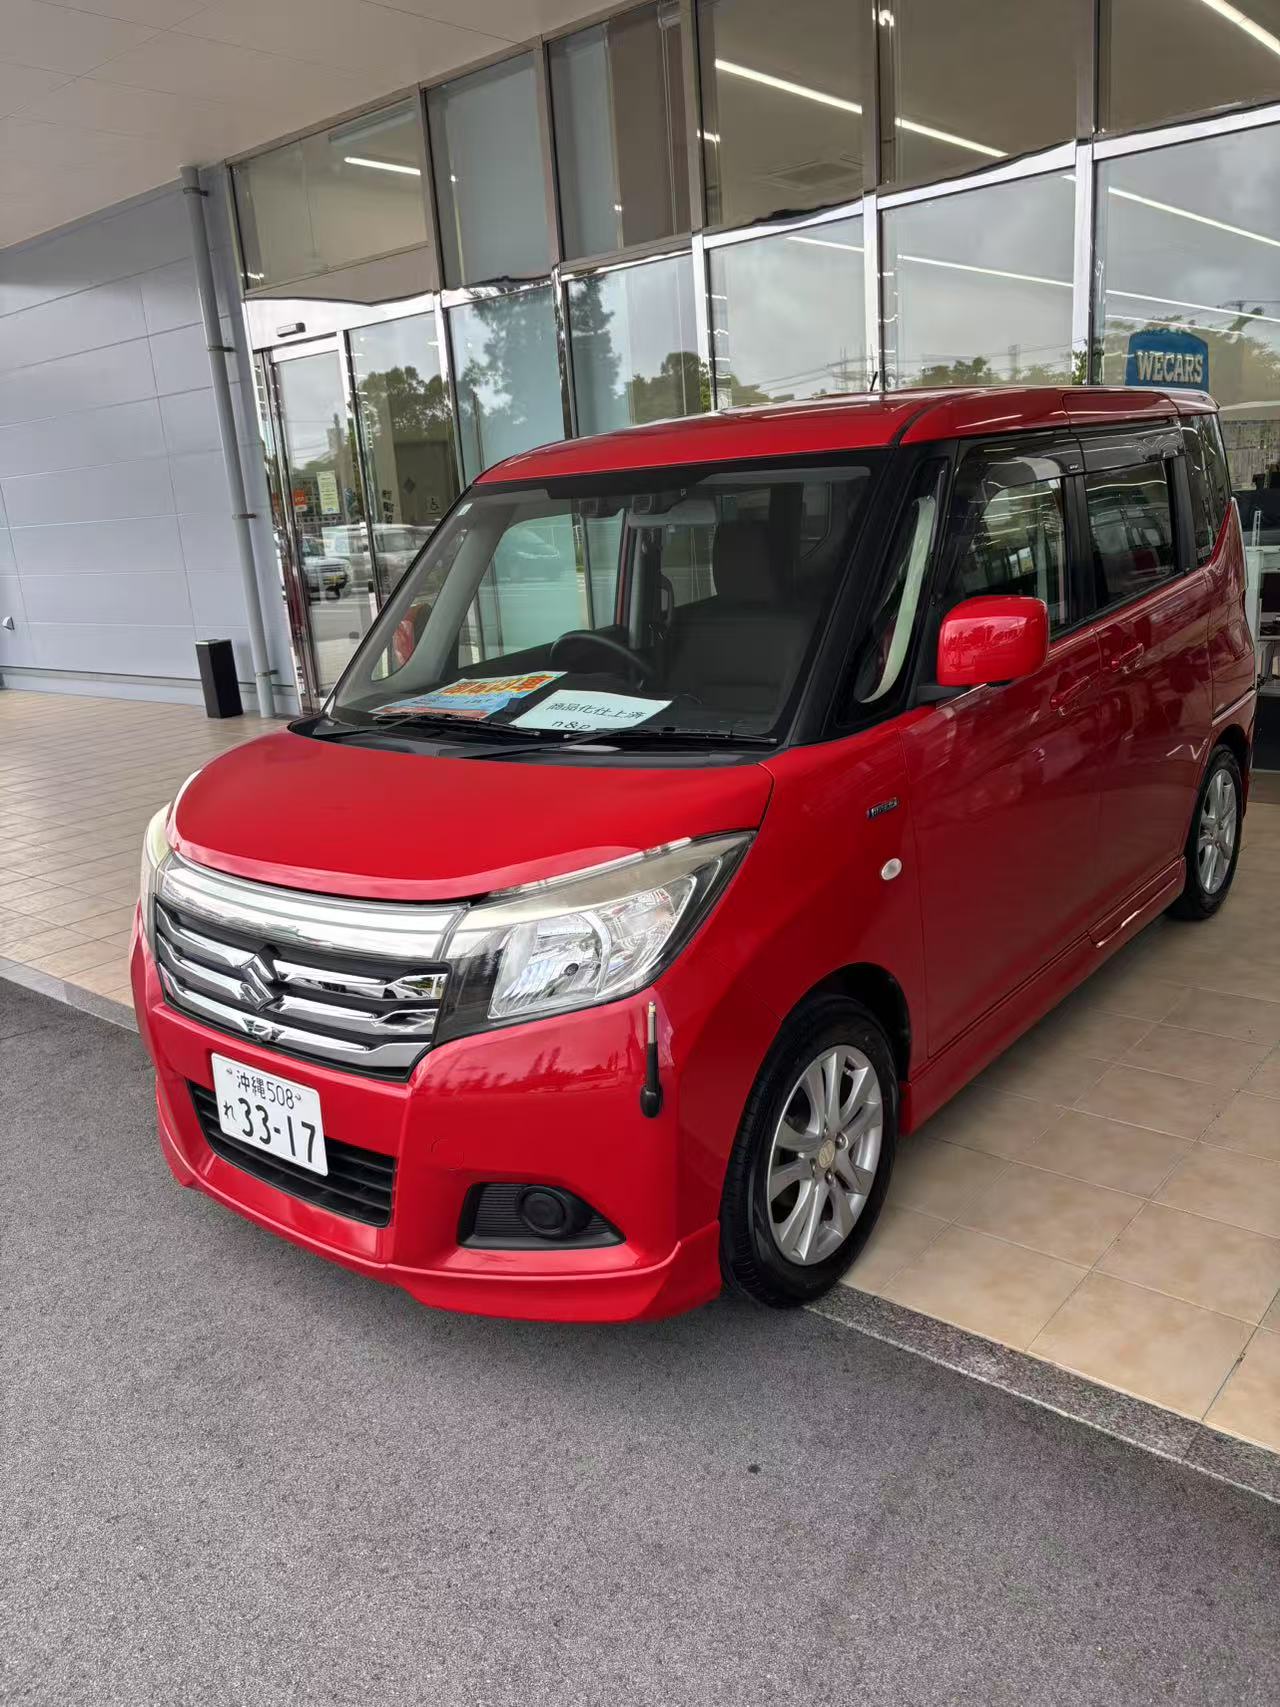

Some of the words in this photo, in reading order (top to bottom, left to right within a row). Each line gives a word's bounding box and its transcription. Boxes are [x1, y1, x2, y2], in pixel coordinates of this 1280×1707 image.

[1136, 351, 1203, 384] WECARS
[223, 1100, 237, 1121] れ
[238, 1097, 316, 1163] 33-17
